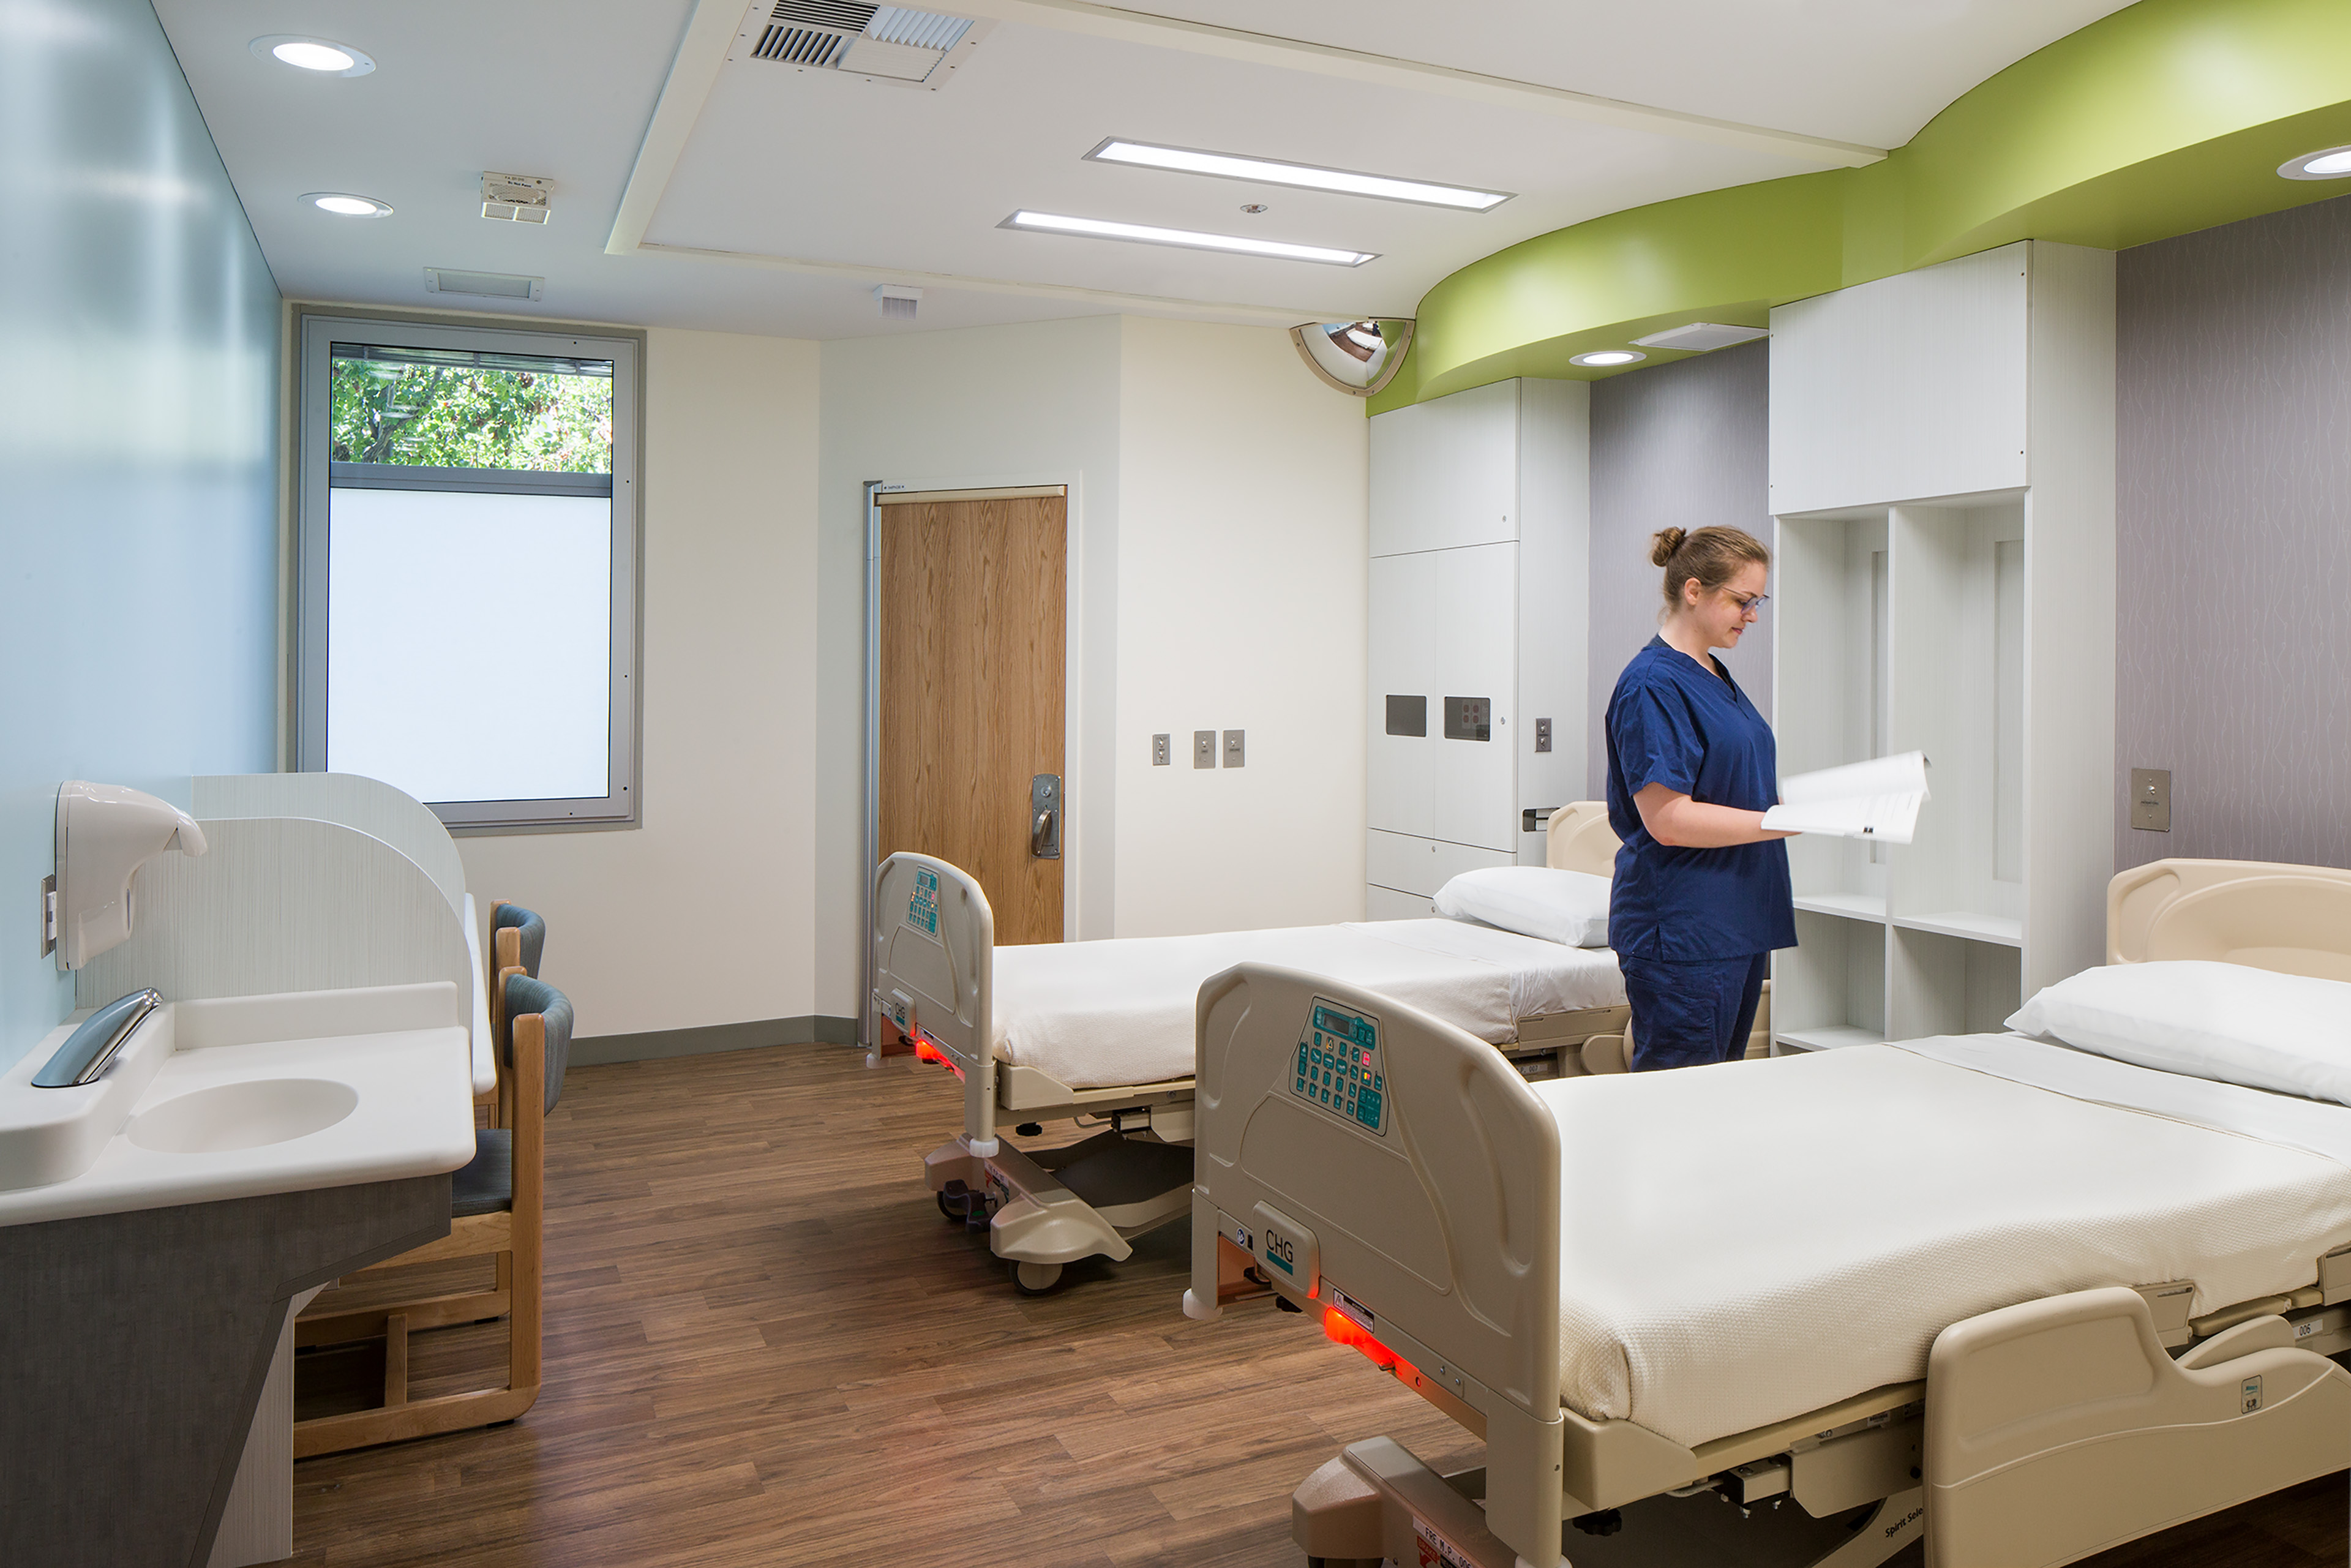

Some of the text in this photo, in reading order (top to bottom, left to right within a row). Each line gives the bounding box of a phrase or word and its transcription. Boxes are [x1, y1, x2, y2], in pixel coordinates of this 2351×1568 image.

[896, 1002, 905, 1019] CHG
[1266, 1229, 1293, 1263] CHG
[2299, 1323, 2311, 1336] 006
[1425, 1527, 1437, 1545] FRE
[1885, 1518, 1907, 1538] Spirit
